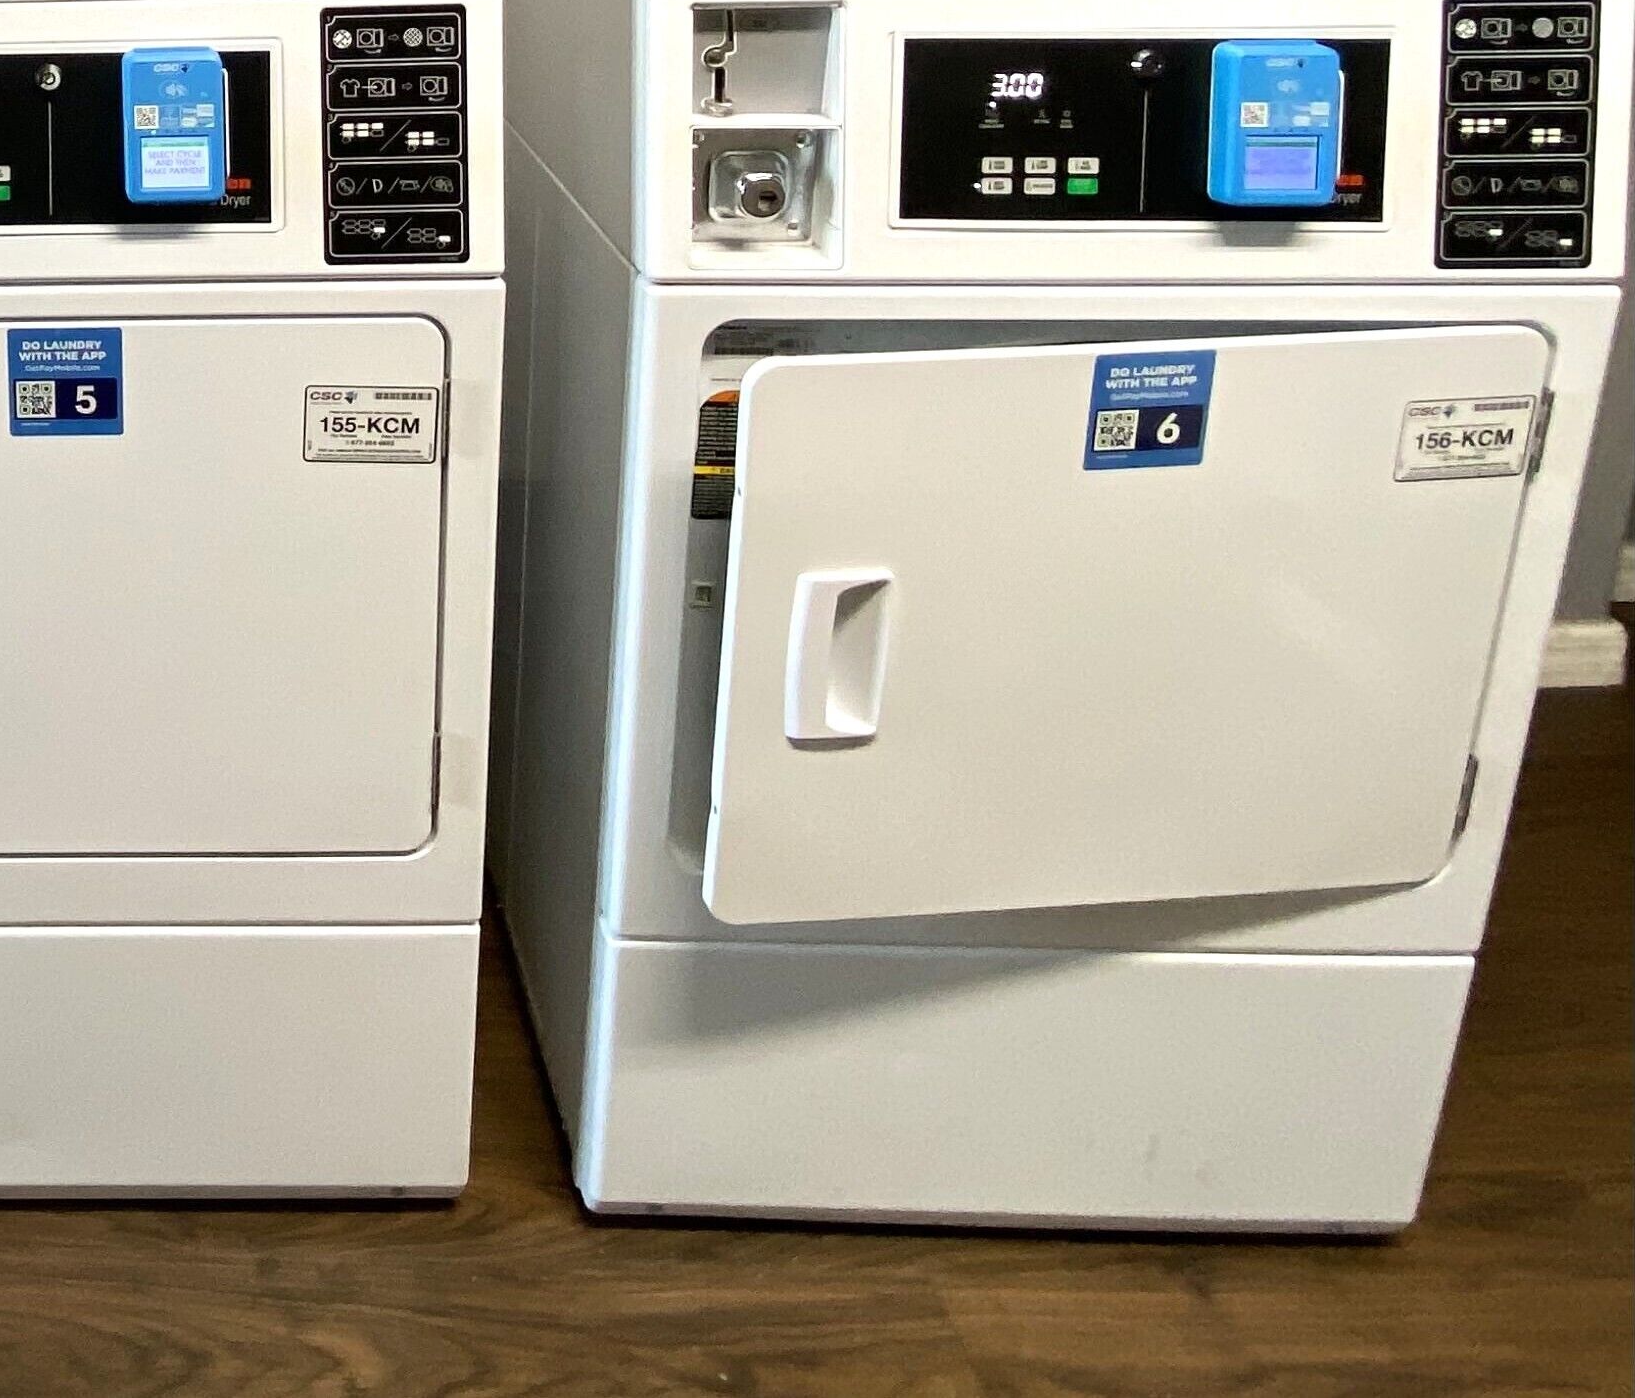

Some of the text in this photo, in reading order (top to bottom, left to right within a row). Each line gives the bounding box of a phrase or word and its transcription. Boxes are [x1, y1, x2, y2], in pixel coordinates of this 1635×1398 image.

[990, 72, 1044, 98] 3.00
[220, 194, 251, 209] Dryer
[22, 340, 102, 350] DO LAUNDRY
[19, 350, 106, 361] WITH THE APP
[1110, 365, 1195, 378] DO LAUNDRY
[1106, 375, 1197, 389] WITH THE APP
[75, 385, 97, 414] 5
[310, 391, 343, 401] CSC
[319, 417, 420, 434] 155-KCM
[1156, 412, 1181, 444] 6
[1415, 428, 1514, 450] 156-KCM
